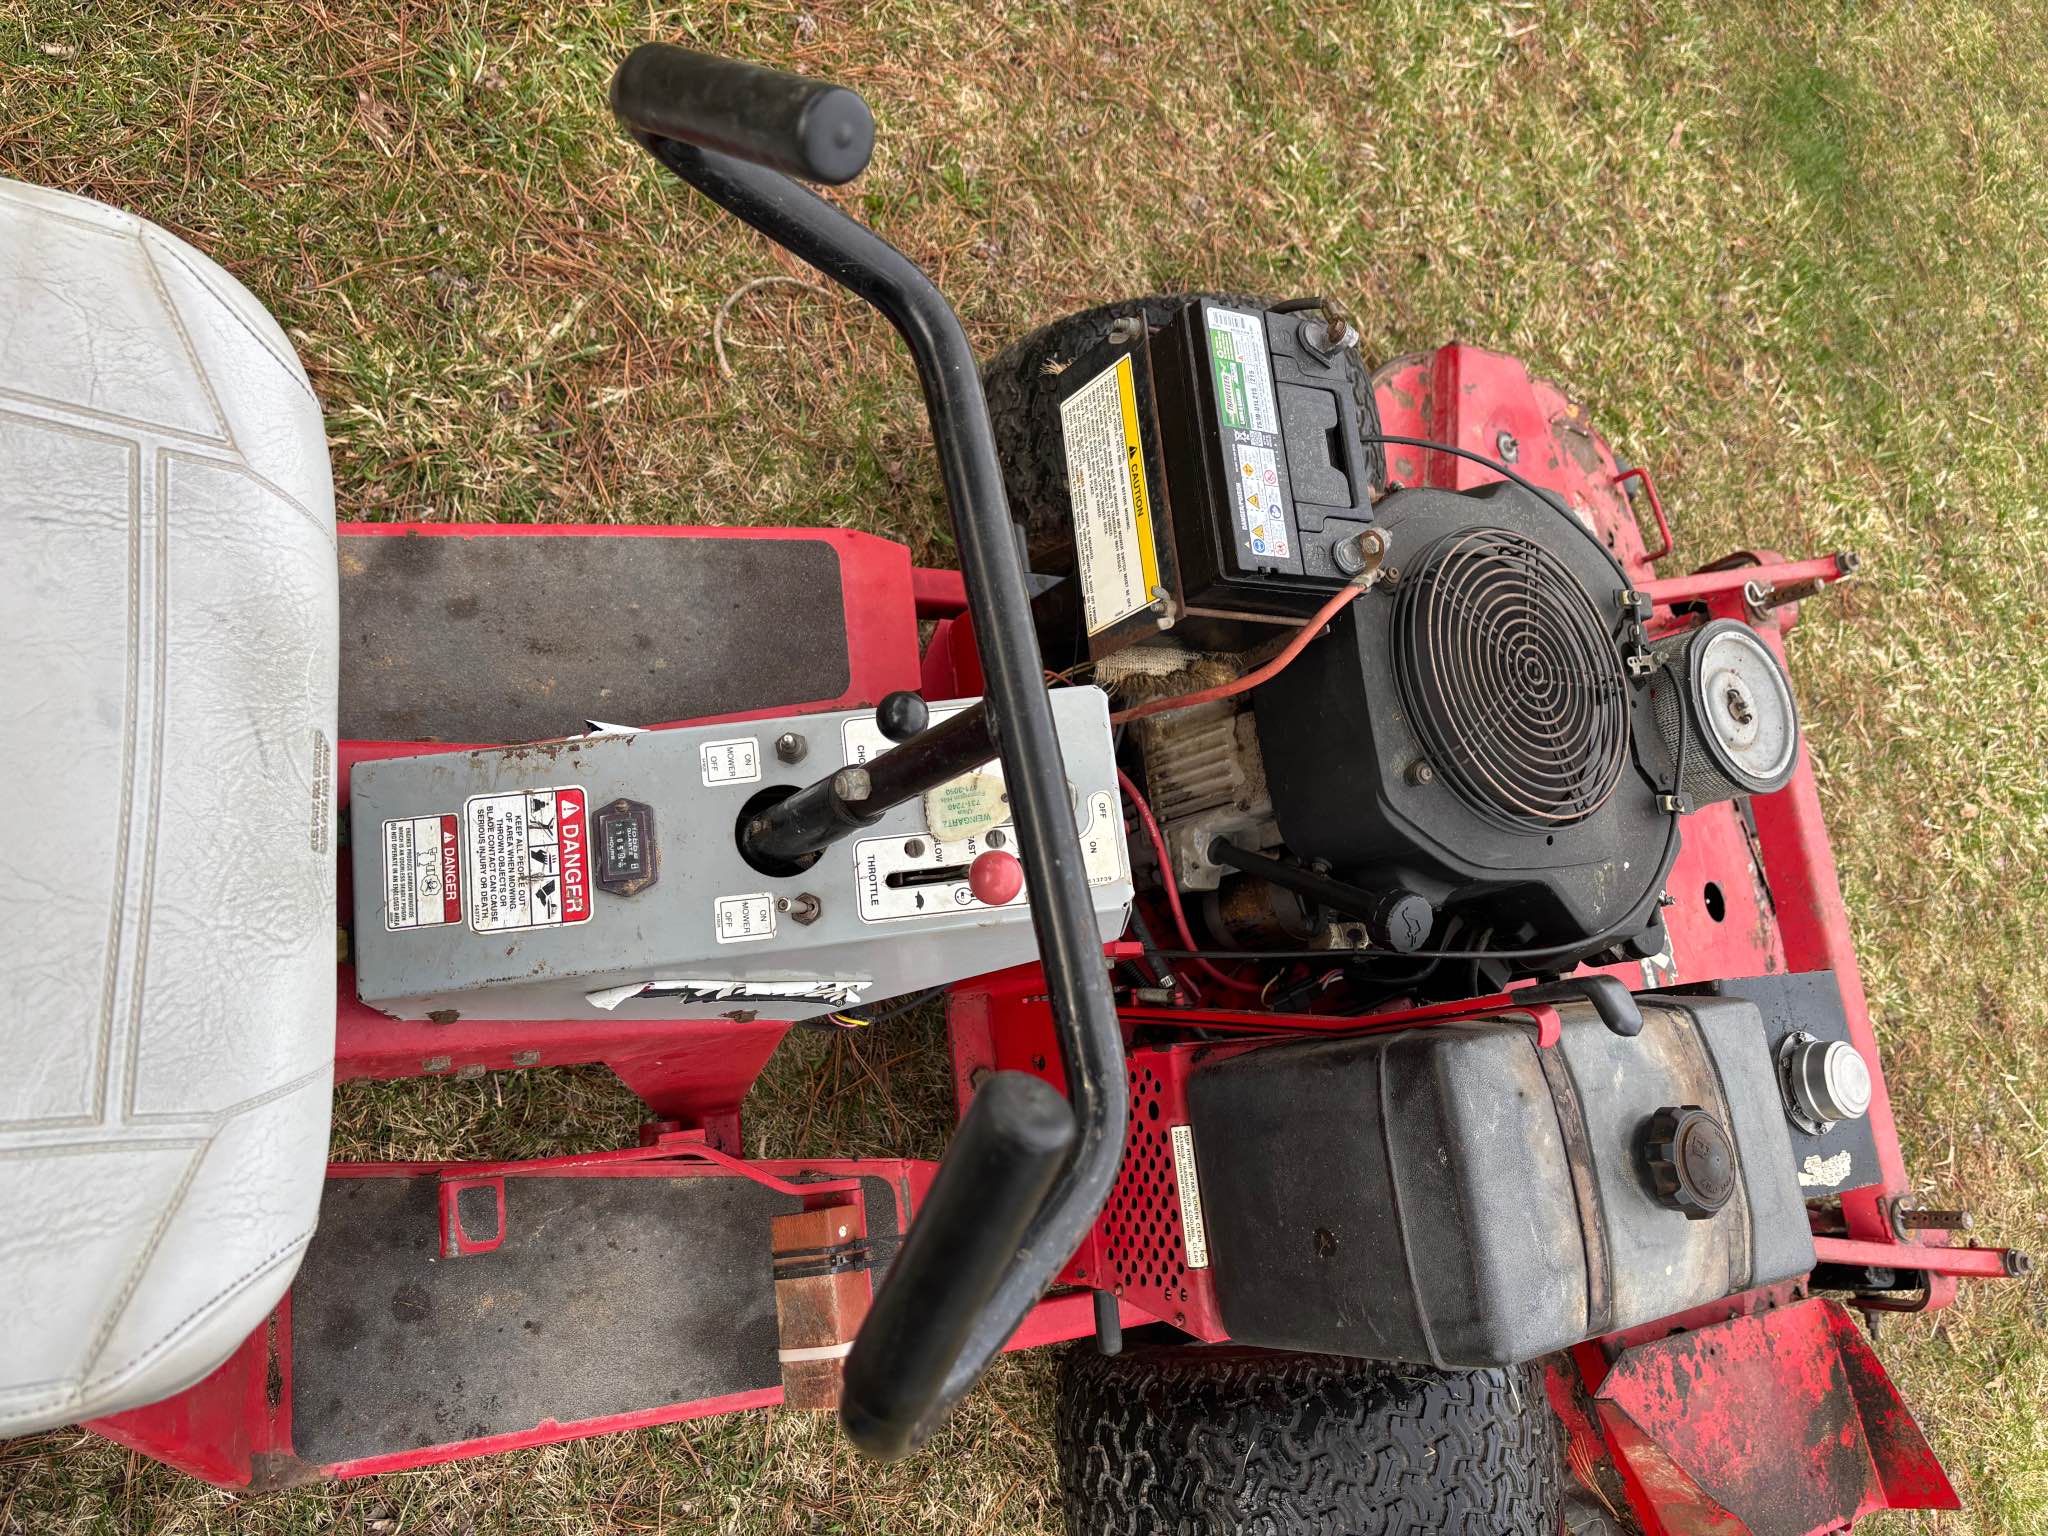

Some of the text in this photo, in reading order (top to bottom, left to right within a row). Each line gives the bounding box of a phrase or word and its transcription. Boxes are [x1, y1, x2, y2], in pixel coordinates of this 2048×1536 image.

[1131, 463, 1144, 517] CAUTION
[710, 756, 718, 771] OFF
[727, 747, 735, 777] MOWER
[744, 753, 752, 766] ON
[857, 745, 866, 764] CHO
[505, 811, 512, 822] OF
[943, 813, 992, 828] WEINGARTZ
[1098, 802, 1107, 819] OFF
[477, 808, 485, 844] SERIOUS
[496, 818, 506, 906] THROWN OBJECTS OR
[1089, 841, 1097, 854] ON
[444, 847, 456, 900] DANGER
[486, 805, 494, 832] BLADE
[490, 894, 498, 922] CAUSE
[516, 855, 524, 887] PEOPLE
[562, 823, 583, 912] DANGER
[480, 877, 487, 889] OR
[508, 875, 516, 911] MOWING.
[867, 854, 879, 906] THROTTLE
[725, 912, 733, 928] OFF
[742, 901, 750, 933] MOWER
[760, 910, 767, 922] ON
